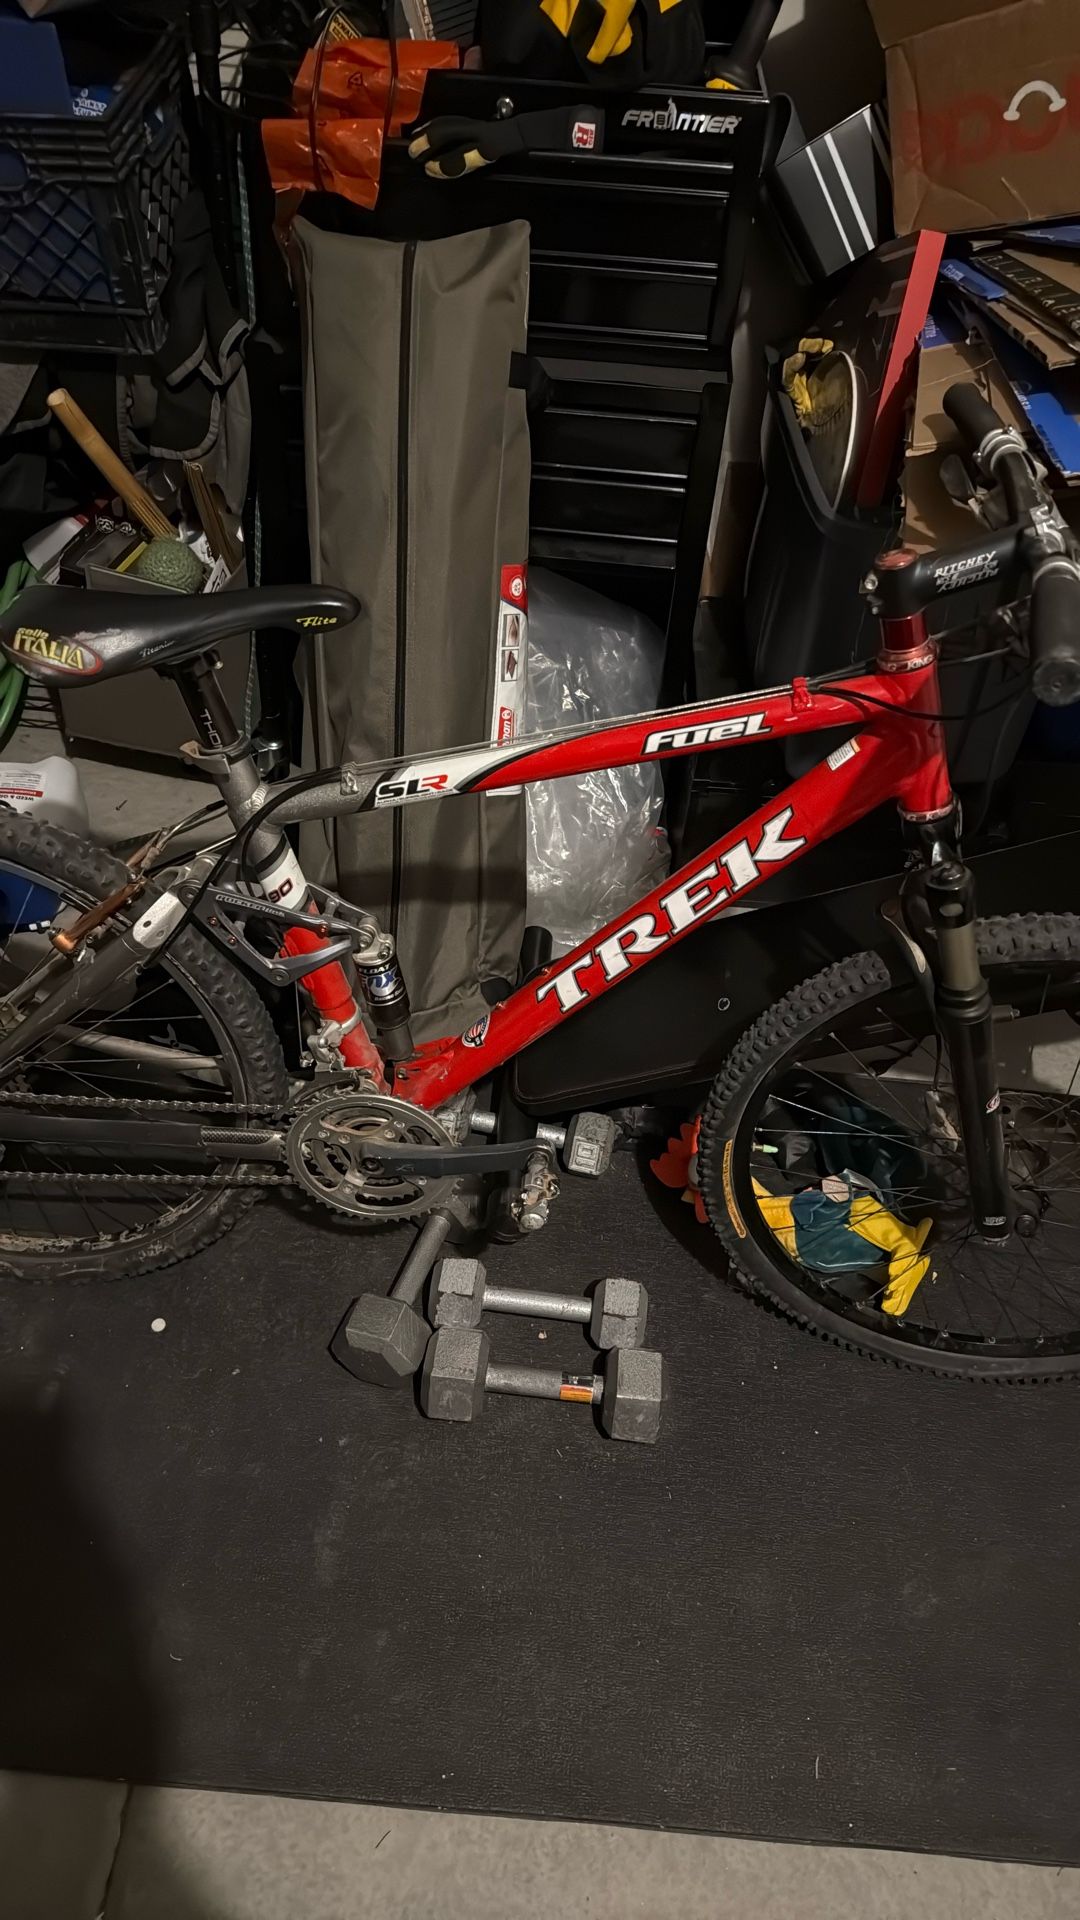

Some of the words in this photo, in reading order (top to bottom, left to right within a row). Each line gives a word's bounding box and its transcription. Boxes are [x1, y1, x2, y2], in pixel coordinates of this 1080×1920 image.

[621, 98, 742, 135] FRONTIER
[933, 550, 997, 578] RITCHEY
[296, 616, 337, 628] Flite
[13, 634, 84, 670] ITALIA
[377, 774, 448, 801] SLR
[536, 804, 808, 1014] TREK
